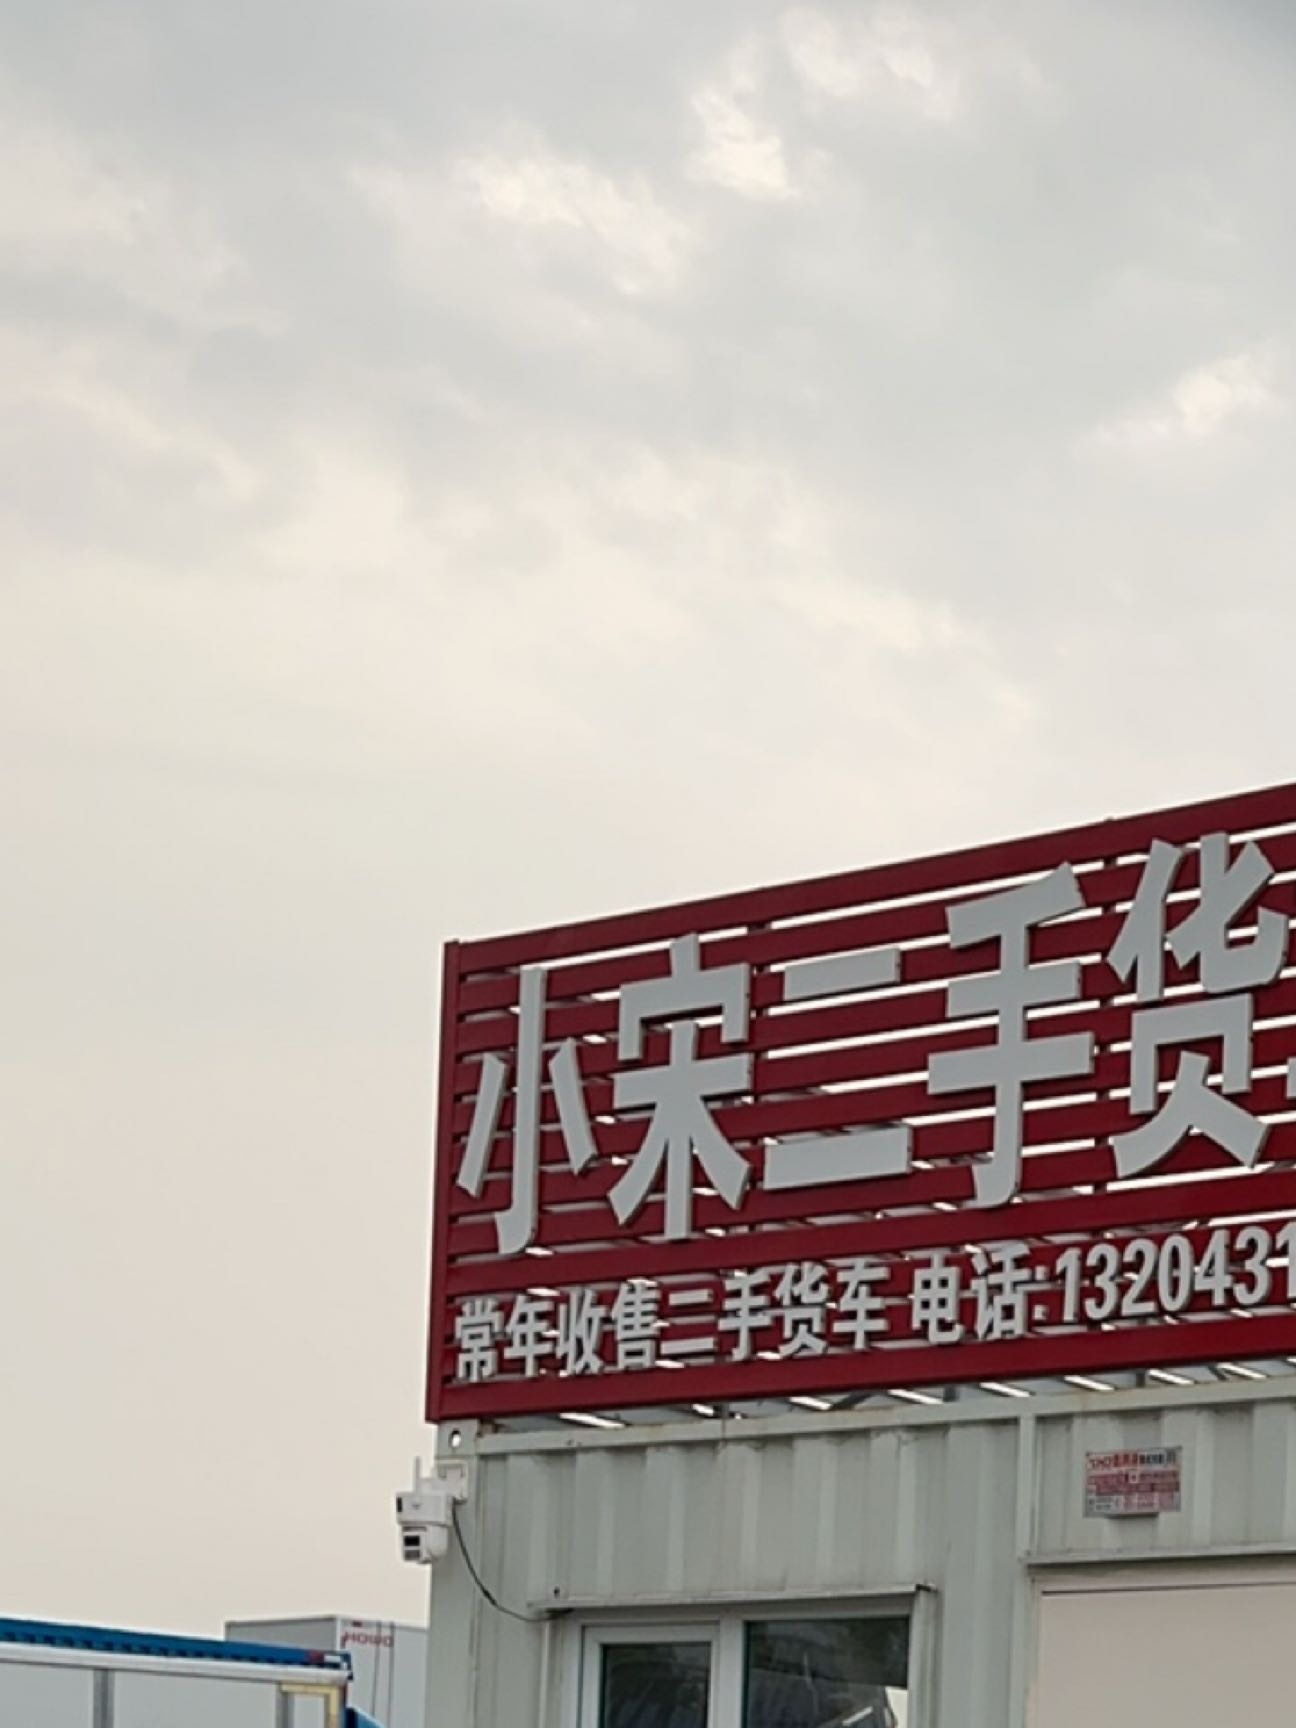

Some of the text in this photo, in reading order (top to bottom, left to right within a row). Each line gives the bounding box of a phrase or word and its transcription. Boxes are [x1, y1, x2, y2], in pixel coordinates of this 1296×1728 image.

[453, 1257, 890, 1383] 常年收售二手货车
